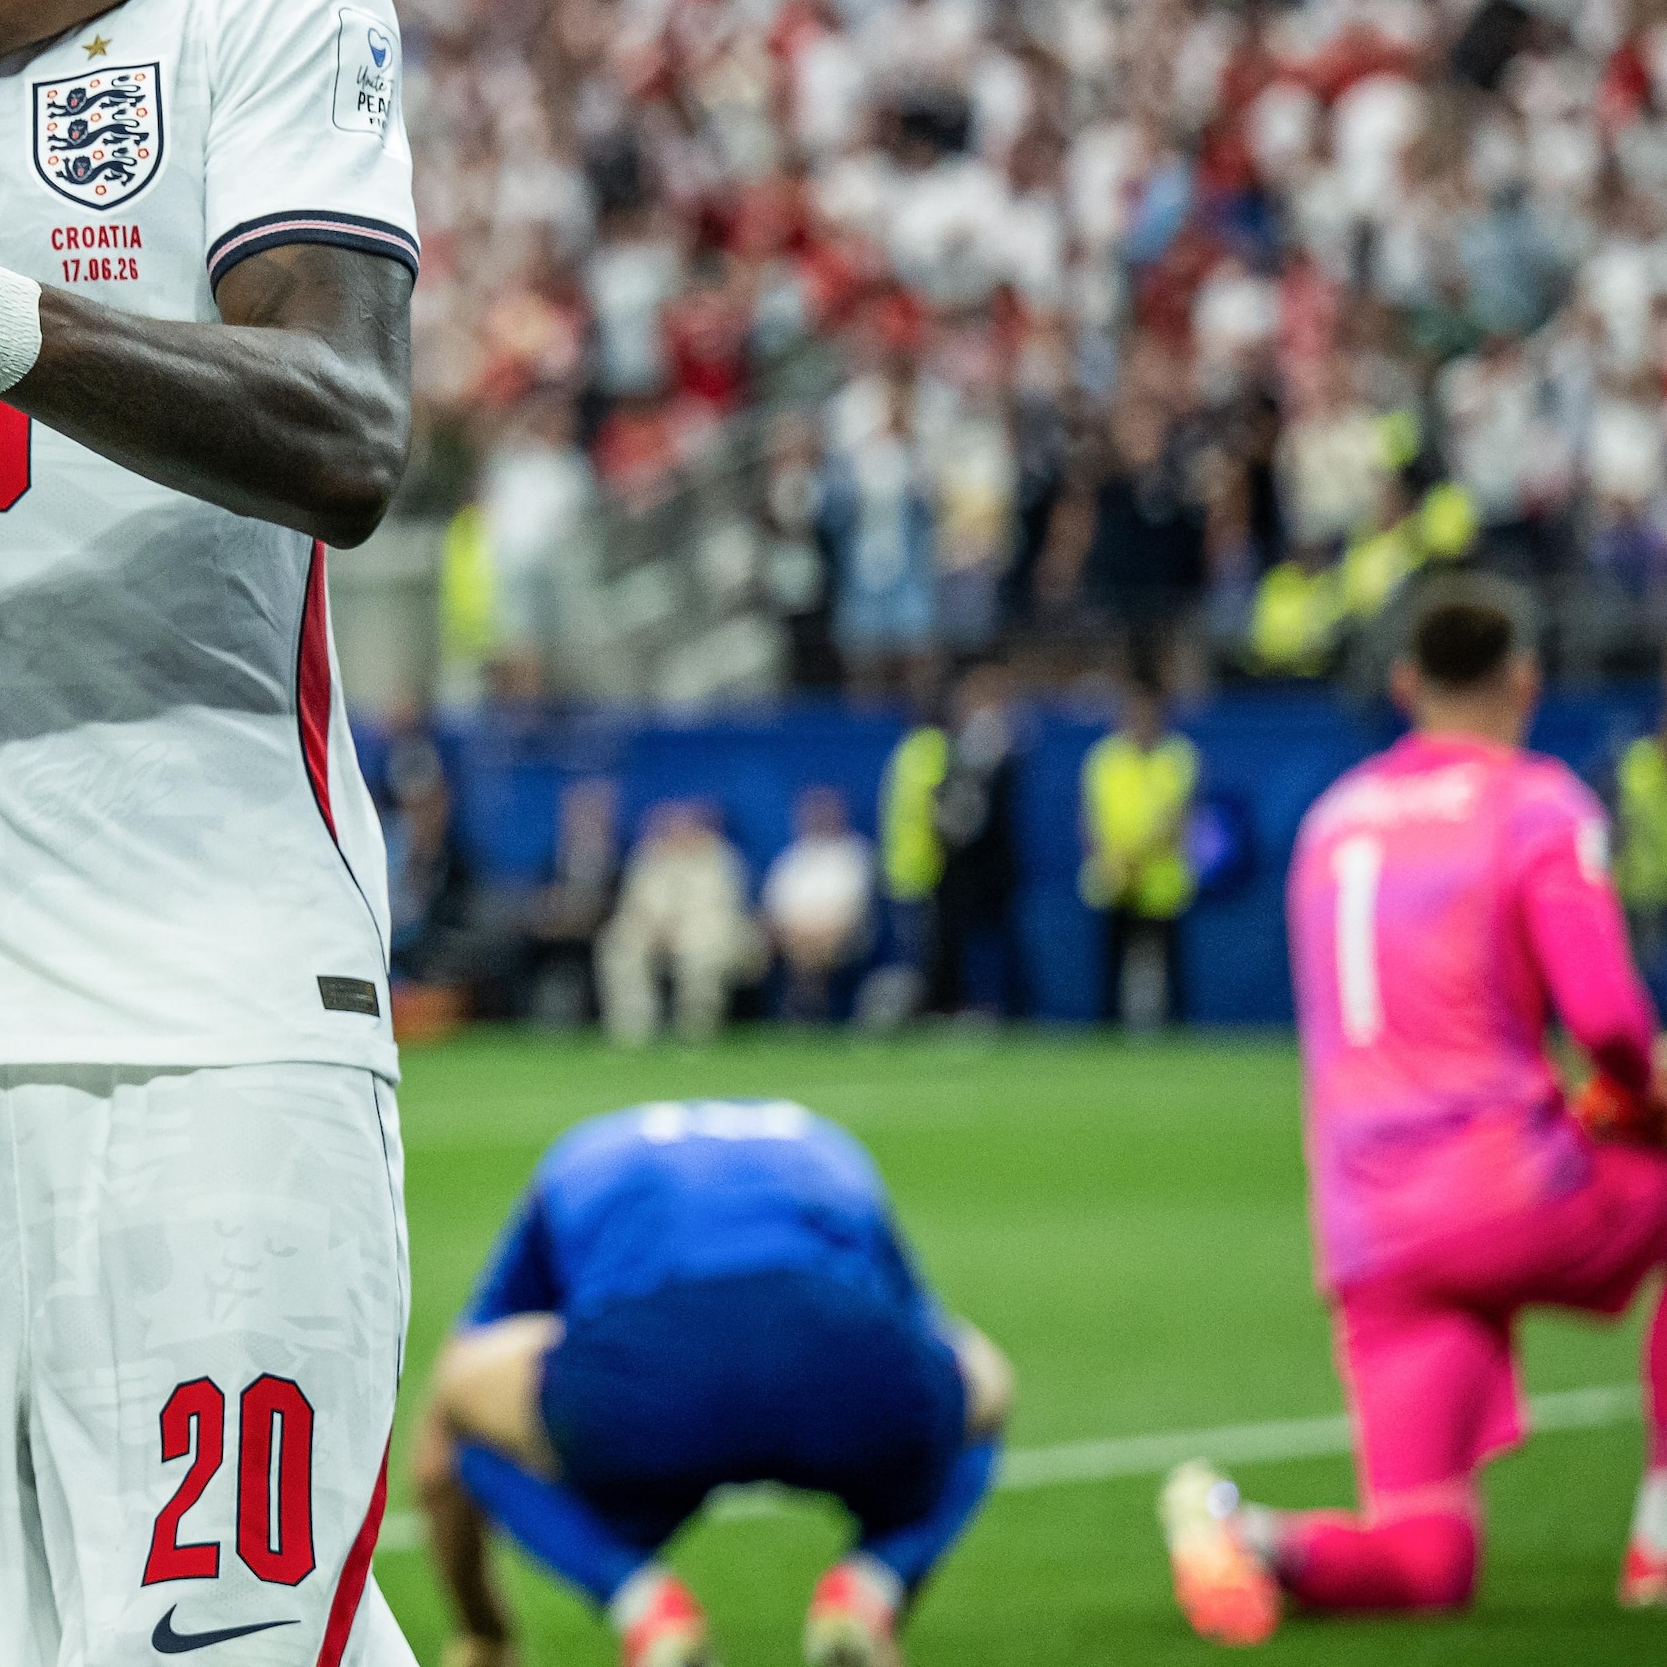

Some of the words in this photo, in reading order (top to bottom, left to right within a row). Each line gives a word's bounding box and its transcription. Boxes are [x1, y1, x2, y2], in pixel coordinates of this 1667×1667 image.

[357, 91, 391, 114] PEA
[51, 224, 142, 251] CROATIA
[62, 256, 139, 283] 17.06.26
[142, 1372, 315, 1587] 20
